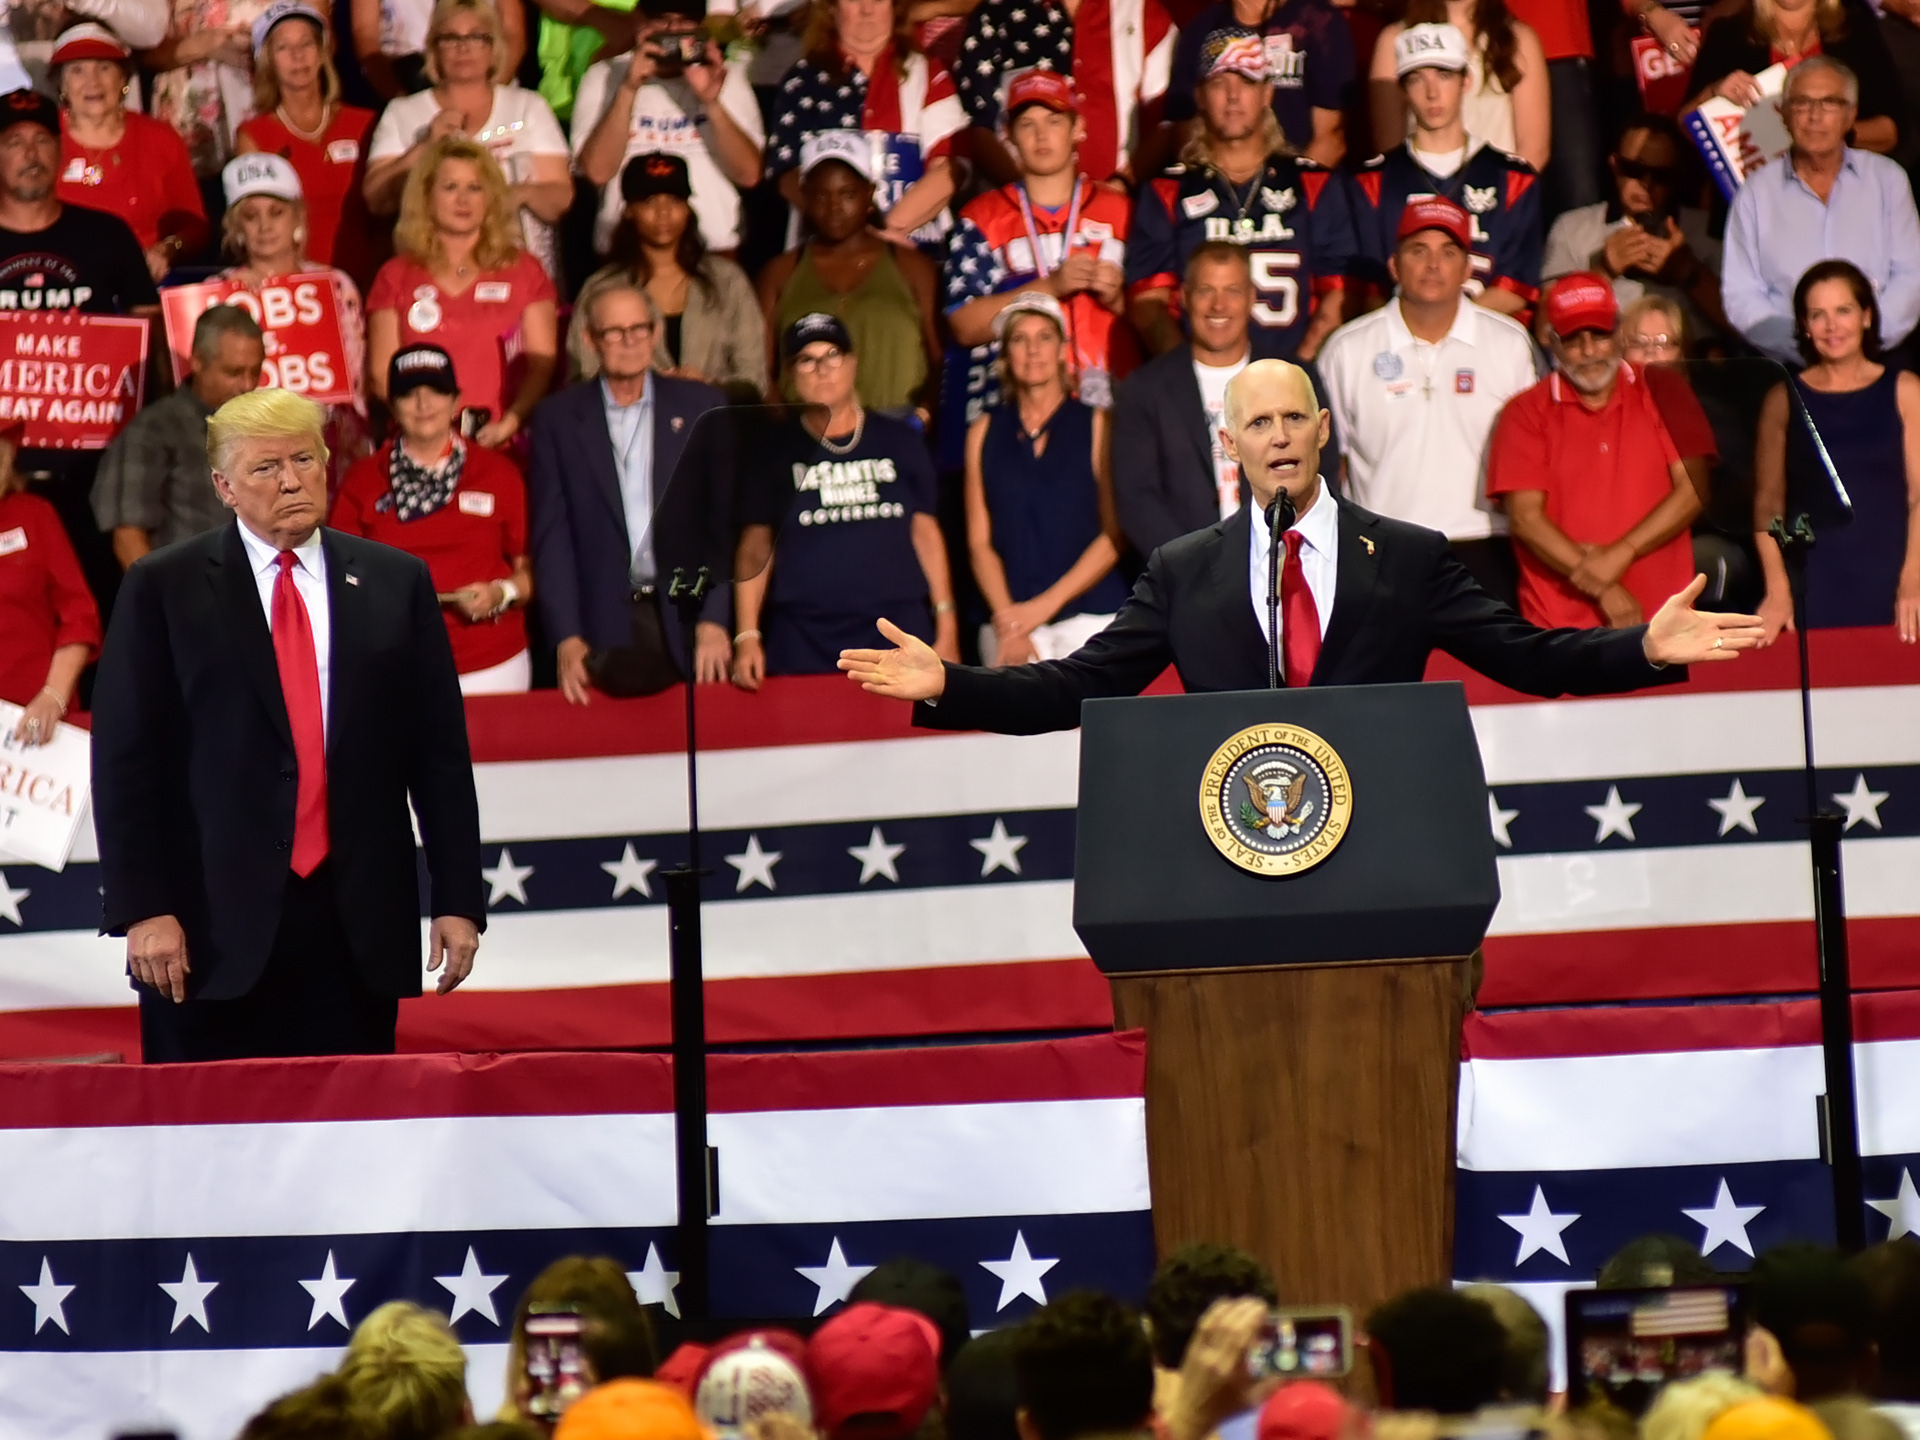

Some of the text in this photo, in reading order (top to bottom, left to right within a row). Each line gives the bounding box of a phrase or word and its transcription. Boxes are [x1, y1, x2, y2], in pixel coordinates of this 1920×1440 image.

[1404, 33, 1445, 54] USA
[237, 164, 276, 184] USA
[16, 333, 82, 358] MAKE
[47, 399, 124, 423] AGAIN
[799, 502, 904, 527] GOVERNOR
[1205, 729, 1347, 869] SEAL OF THE PRESIDENT OF THE UNITED STATES
